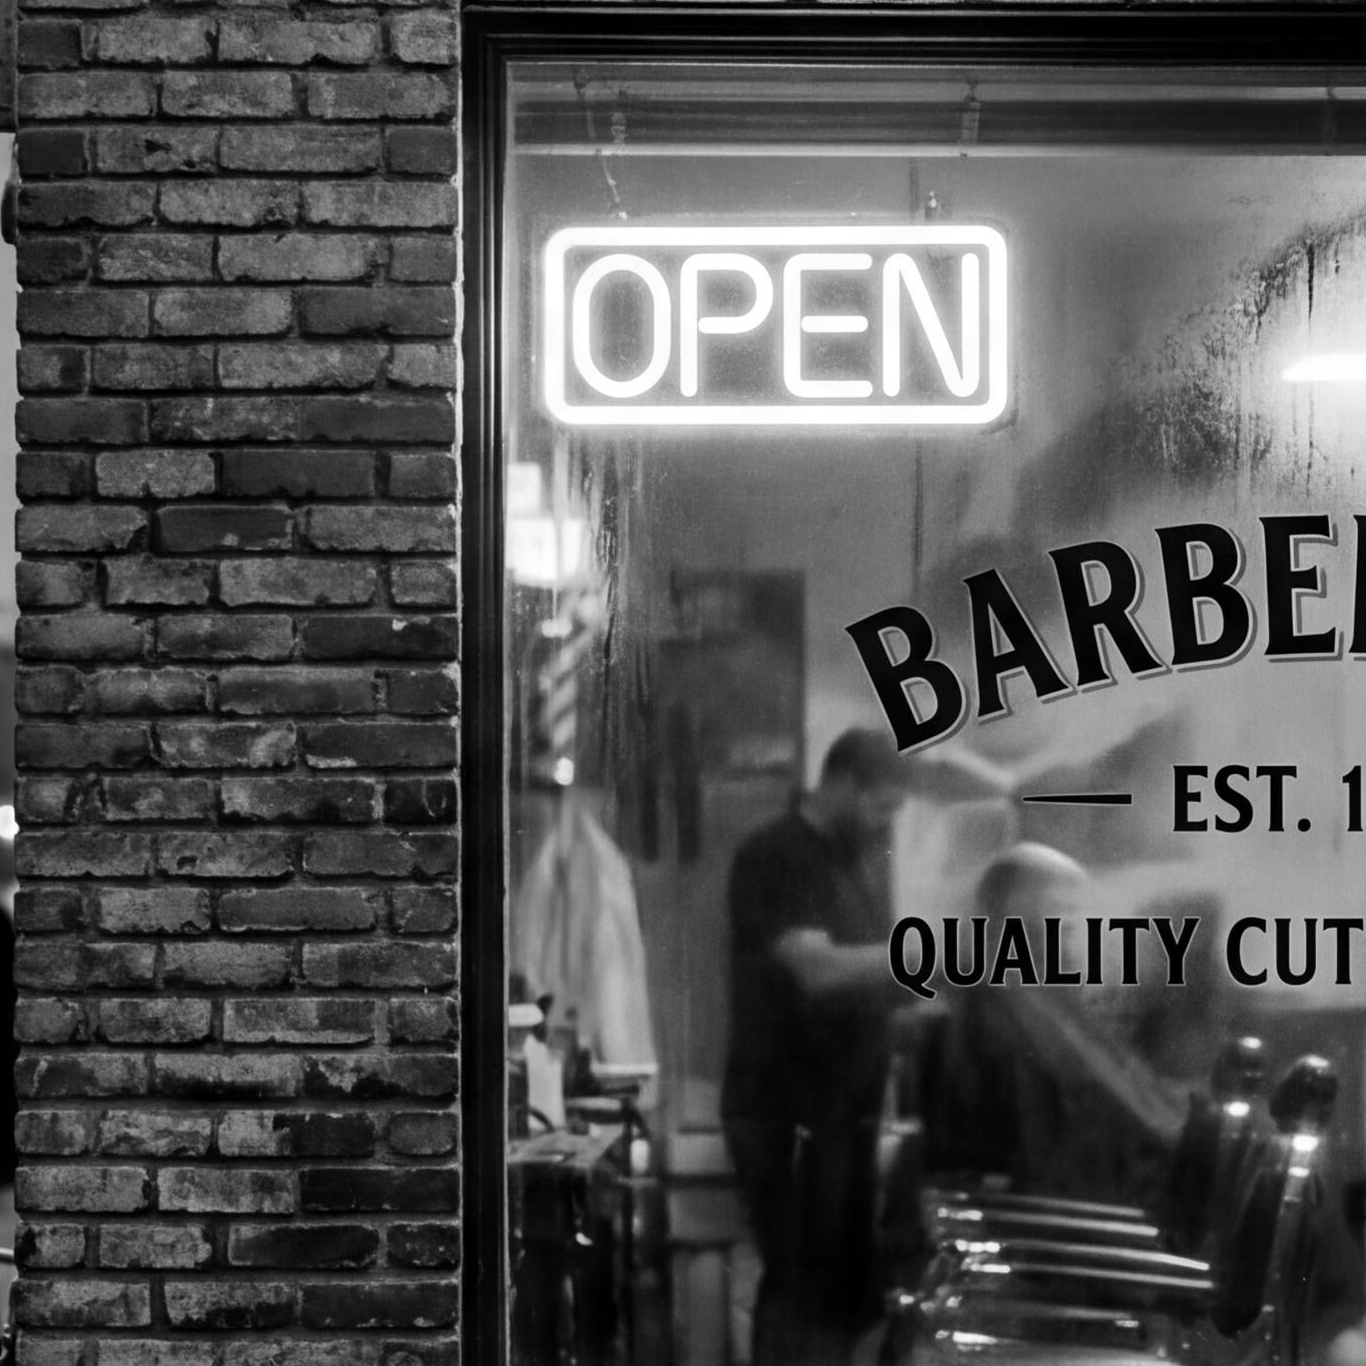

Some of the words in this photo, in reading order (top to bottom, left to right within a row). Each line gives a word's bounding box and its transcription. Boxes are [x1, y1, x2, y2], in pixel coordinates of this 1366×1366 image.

[572, 252, 980, 399] OPEN
[1171, 764, 1313, 834] EST.
[888, 914, 1202, 1000] QUALITY
